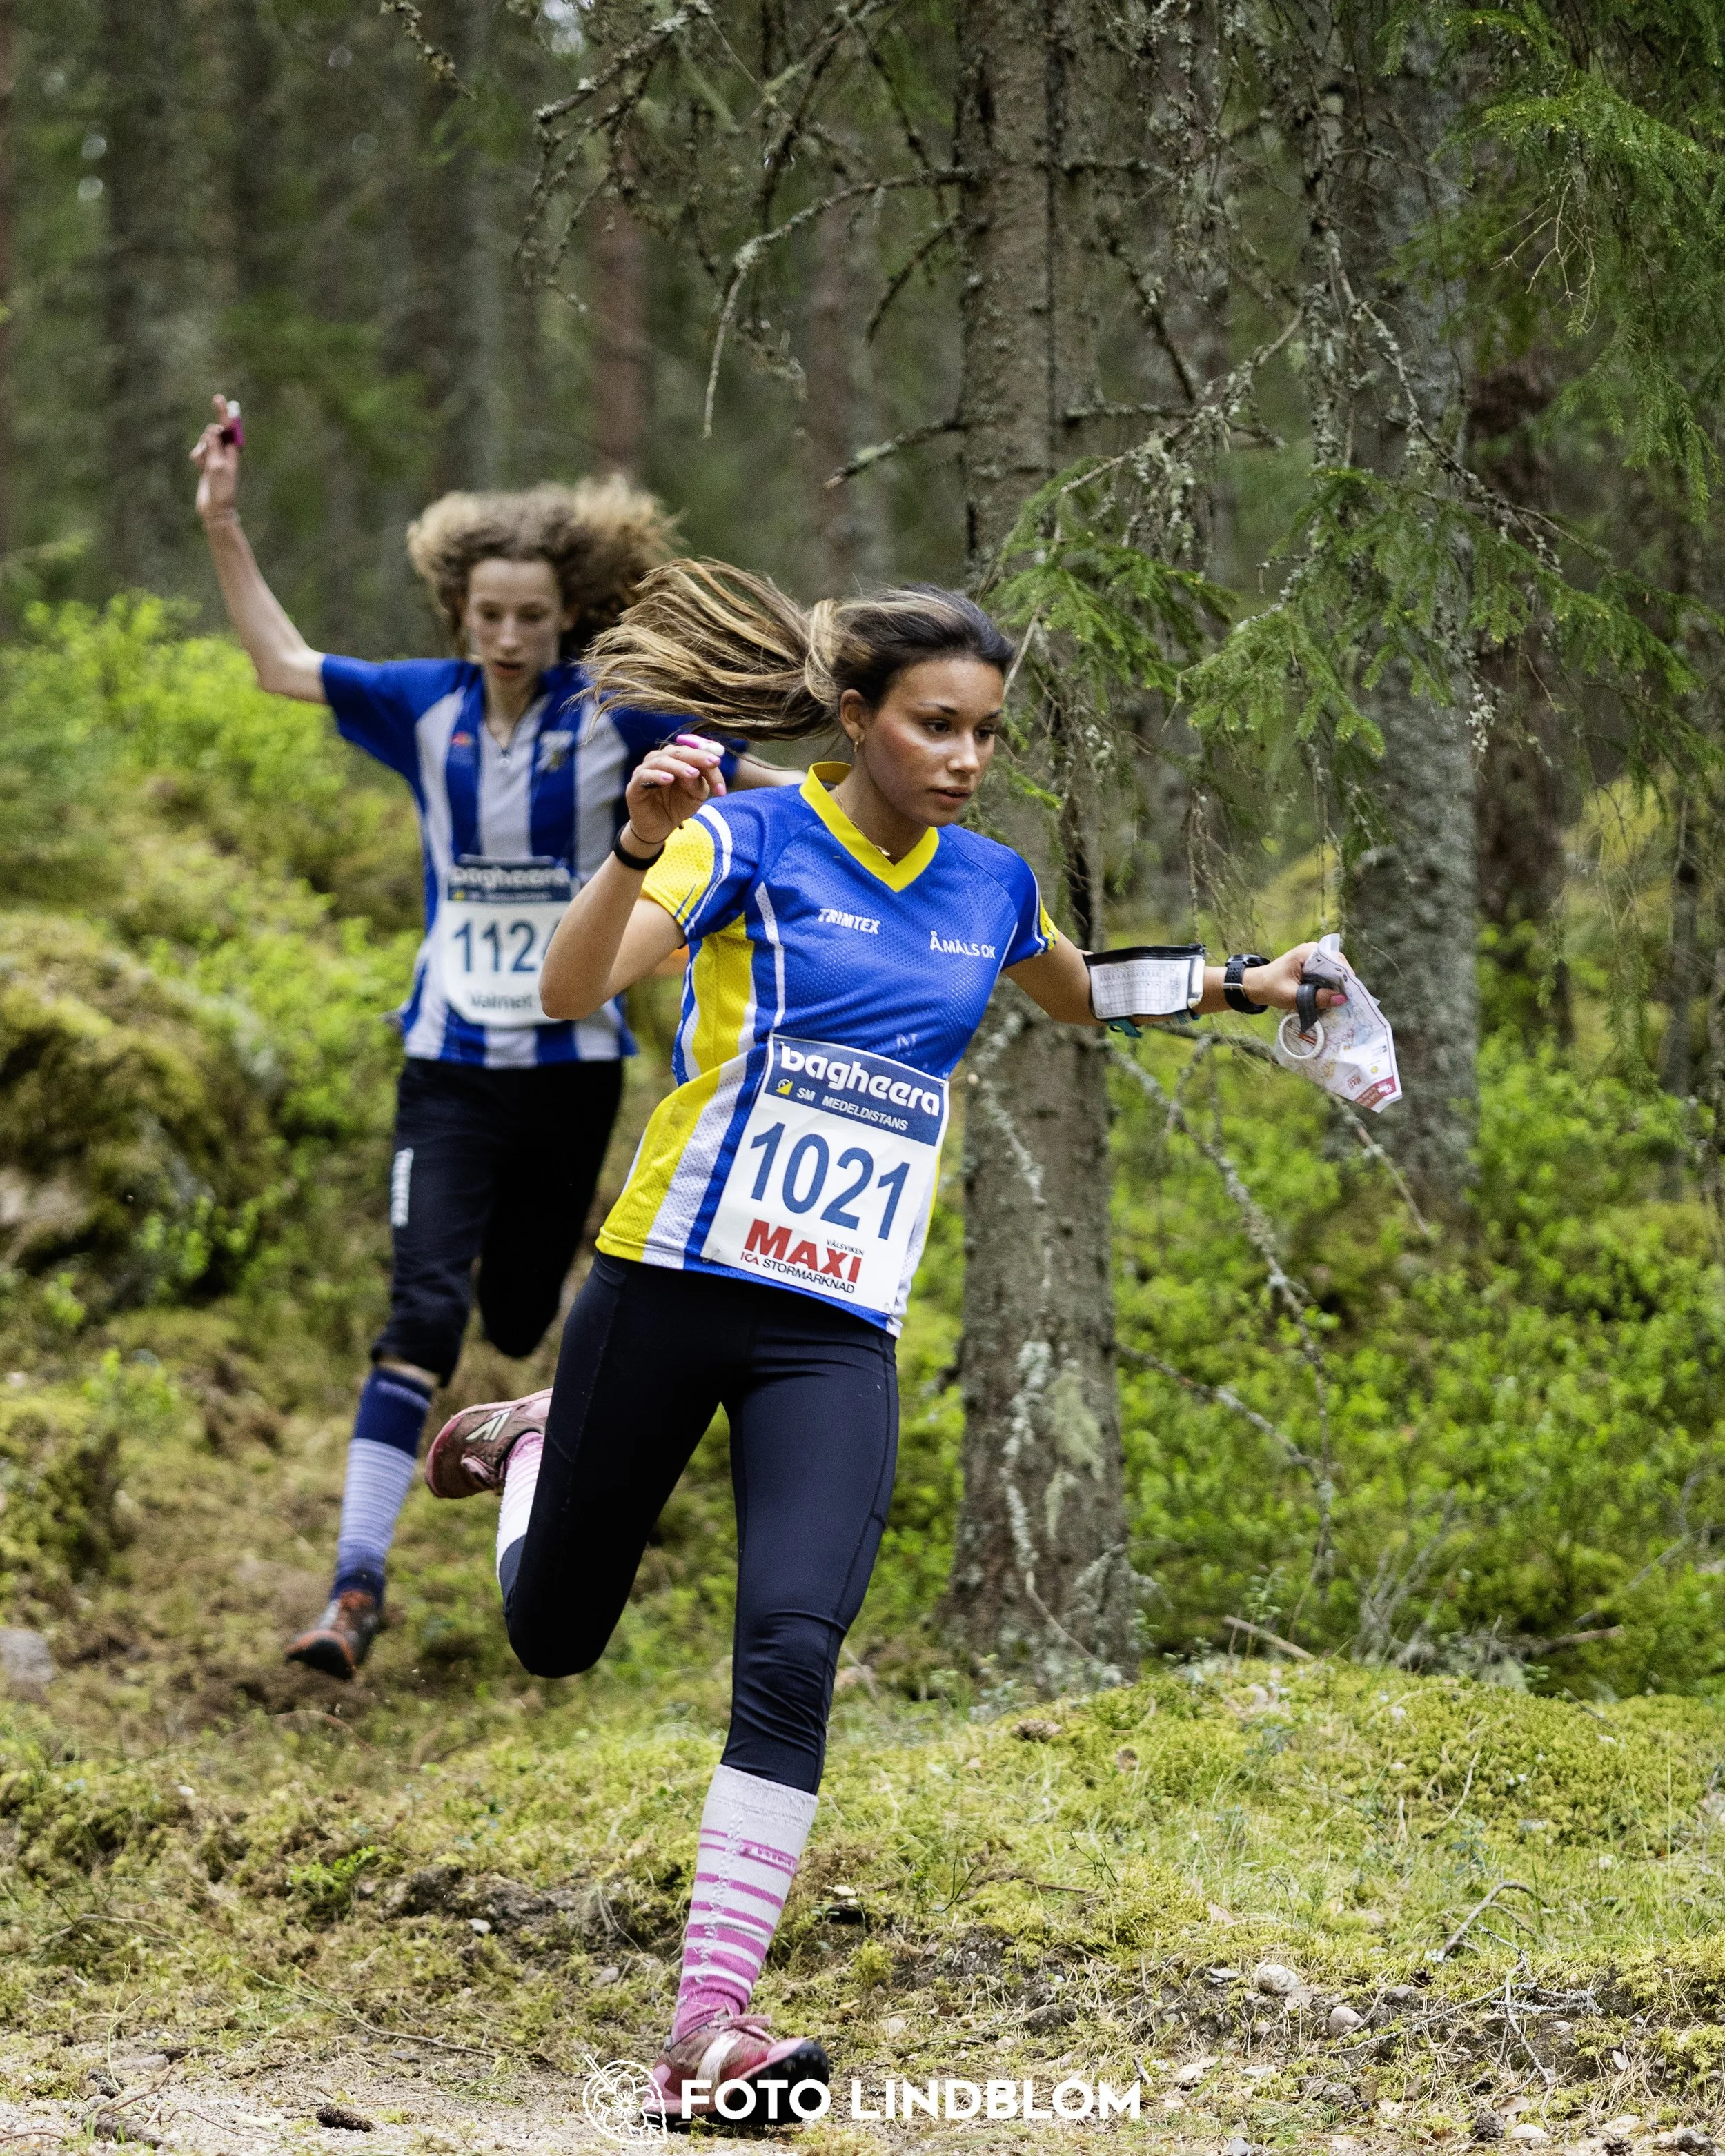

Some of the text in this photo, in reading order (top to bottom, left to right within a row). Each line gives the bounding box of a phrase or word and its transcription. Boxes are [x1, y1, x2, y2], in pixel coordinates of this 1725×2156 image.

[453, 918, 560, 973] 112
[818, 908, 881, 935] TRIMTEX
[780, 1046, 940, 1116] bagheera
[796, 1087, 909, 1131] SM MEDELDISTANS
[750, 1122, 911, 1241] 1021
[740, 1252, 855, 1294] ICA STORMARKNAD
[744, 1218, 862, 1283] MAXI
